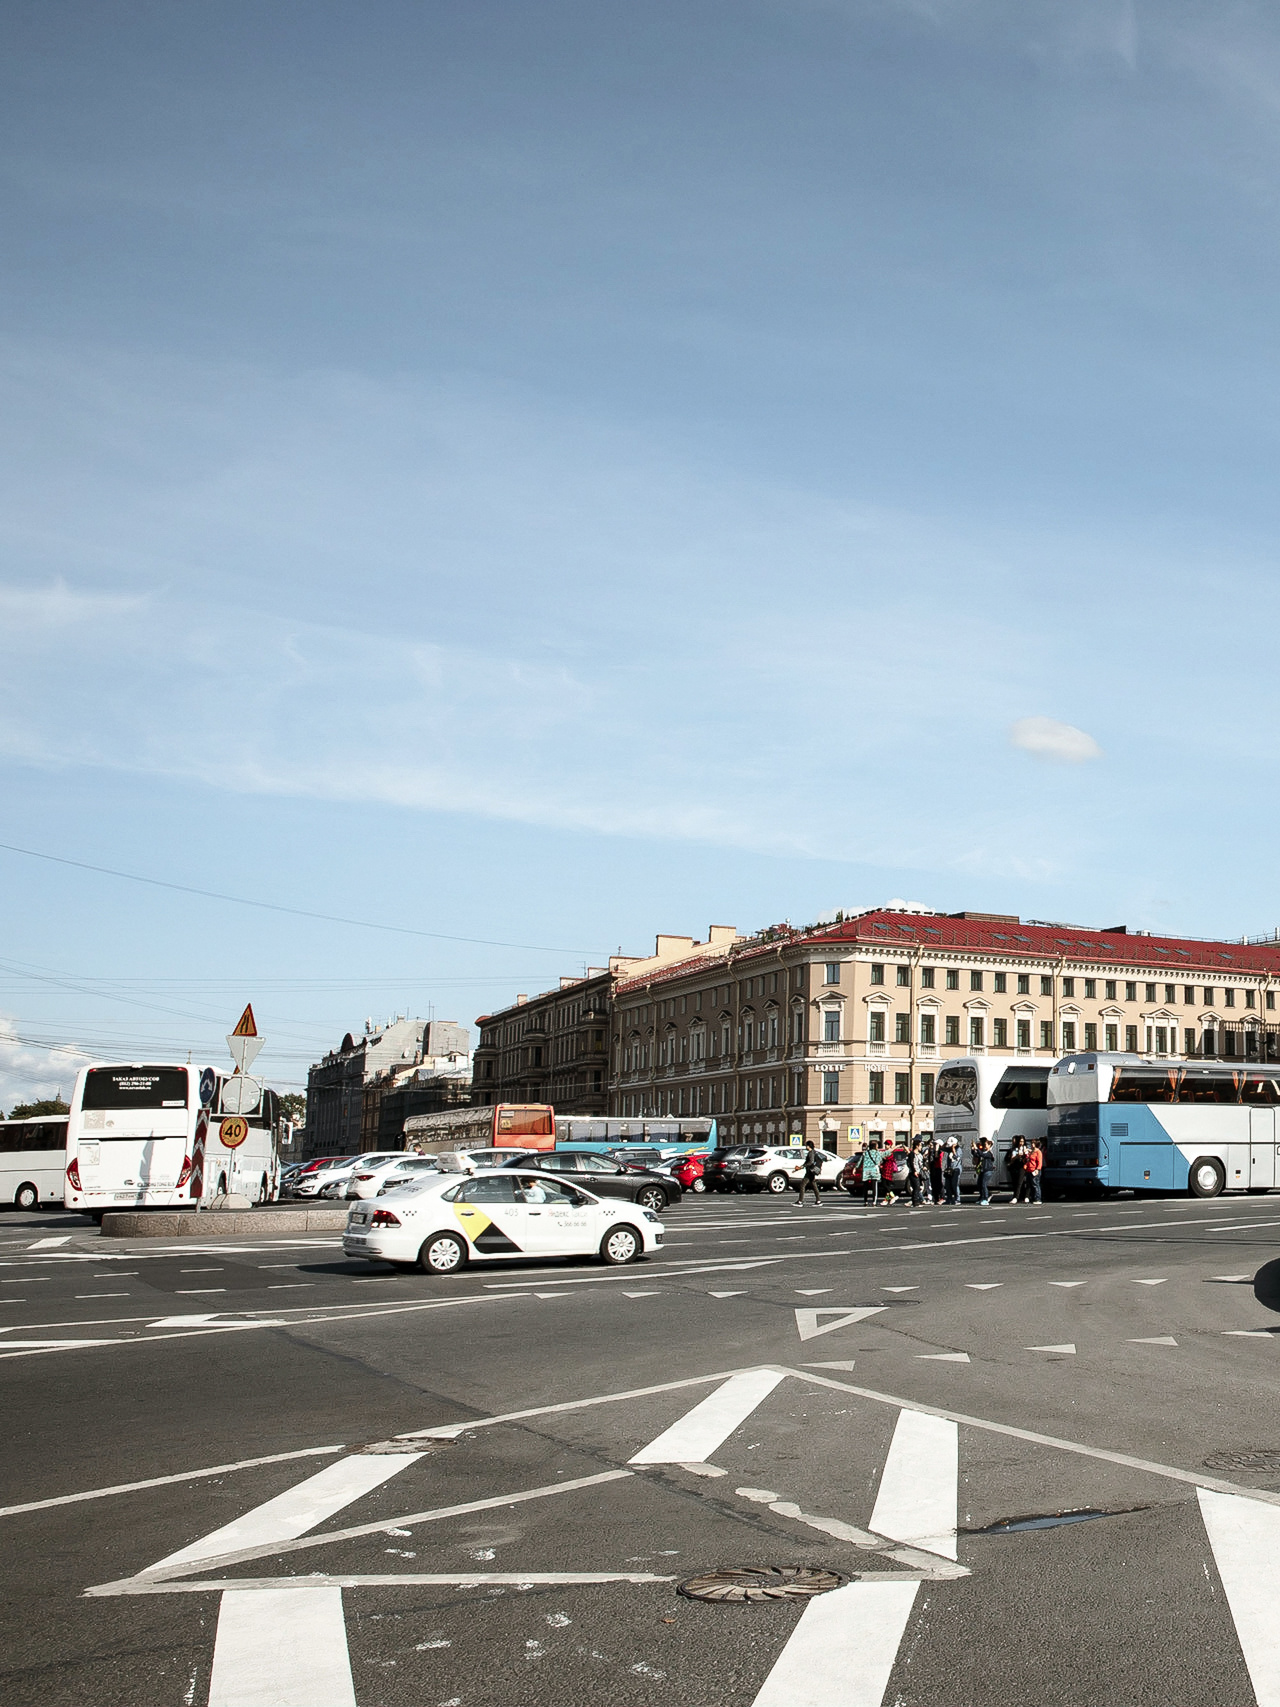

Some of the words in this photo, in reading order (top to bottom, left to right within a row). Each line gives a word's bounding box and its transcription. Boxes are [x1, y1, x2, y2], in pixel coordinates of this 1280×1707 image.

[814, 1064, 847, 1072] LOTTE
[864, 1064, 890, 1072] HOTEL
[225, 1124, 242, 1138] 40
